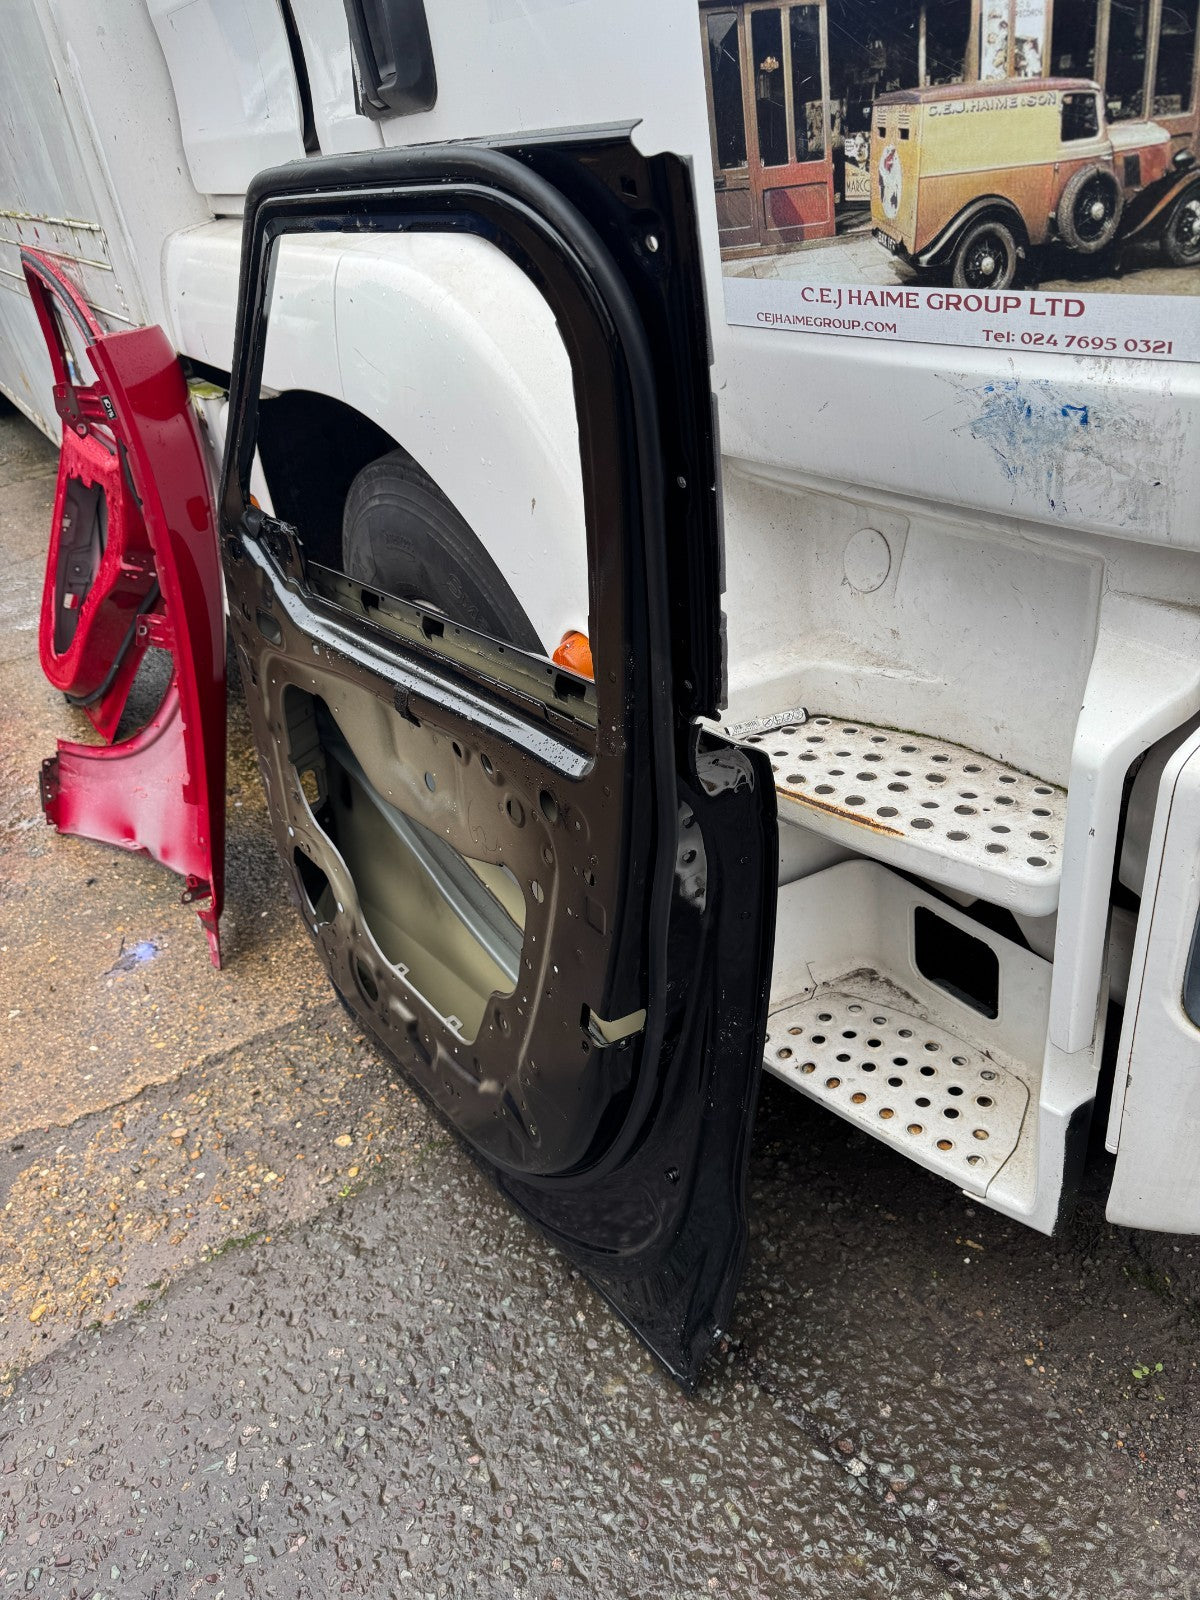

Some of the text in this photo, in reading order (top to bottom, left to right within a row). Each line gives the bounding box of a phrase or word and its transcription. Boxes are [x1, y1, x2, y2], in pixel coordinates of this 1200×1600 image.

[1027, 92, 1057, 107] SON
[801, 287, 1086, 317] C.E.J HAIME GROUP LTD
[756, 311, 897, 334] CEJHAIMEGROUP.COM
[982, 329, 1173, 354] Tel: 024 7695 0321
